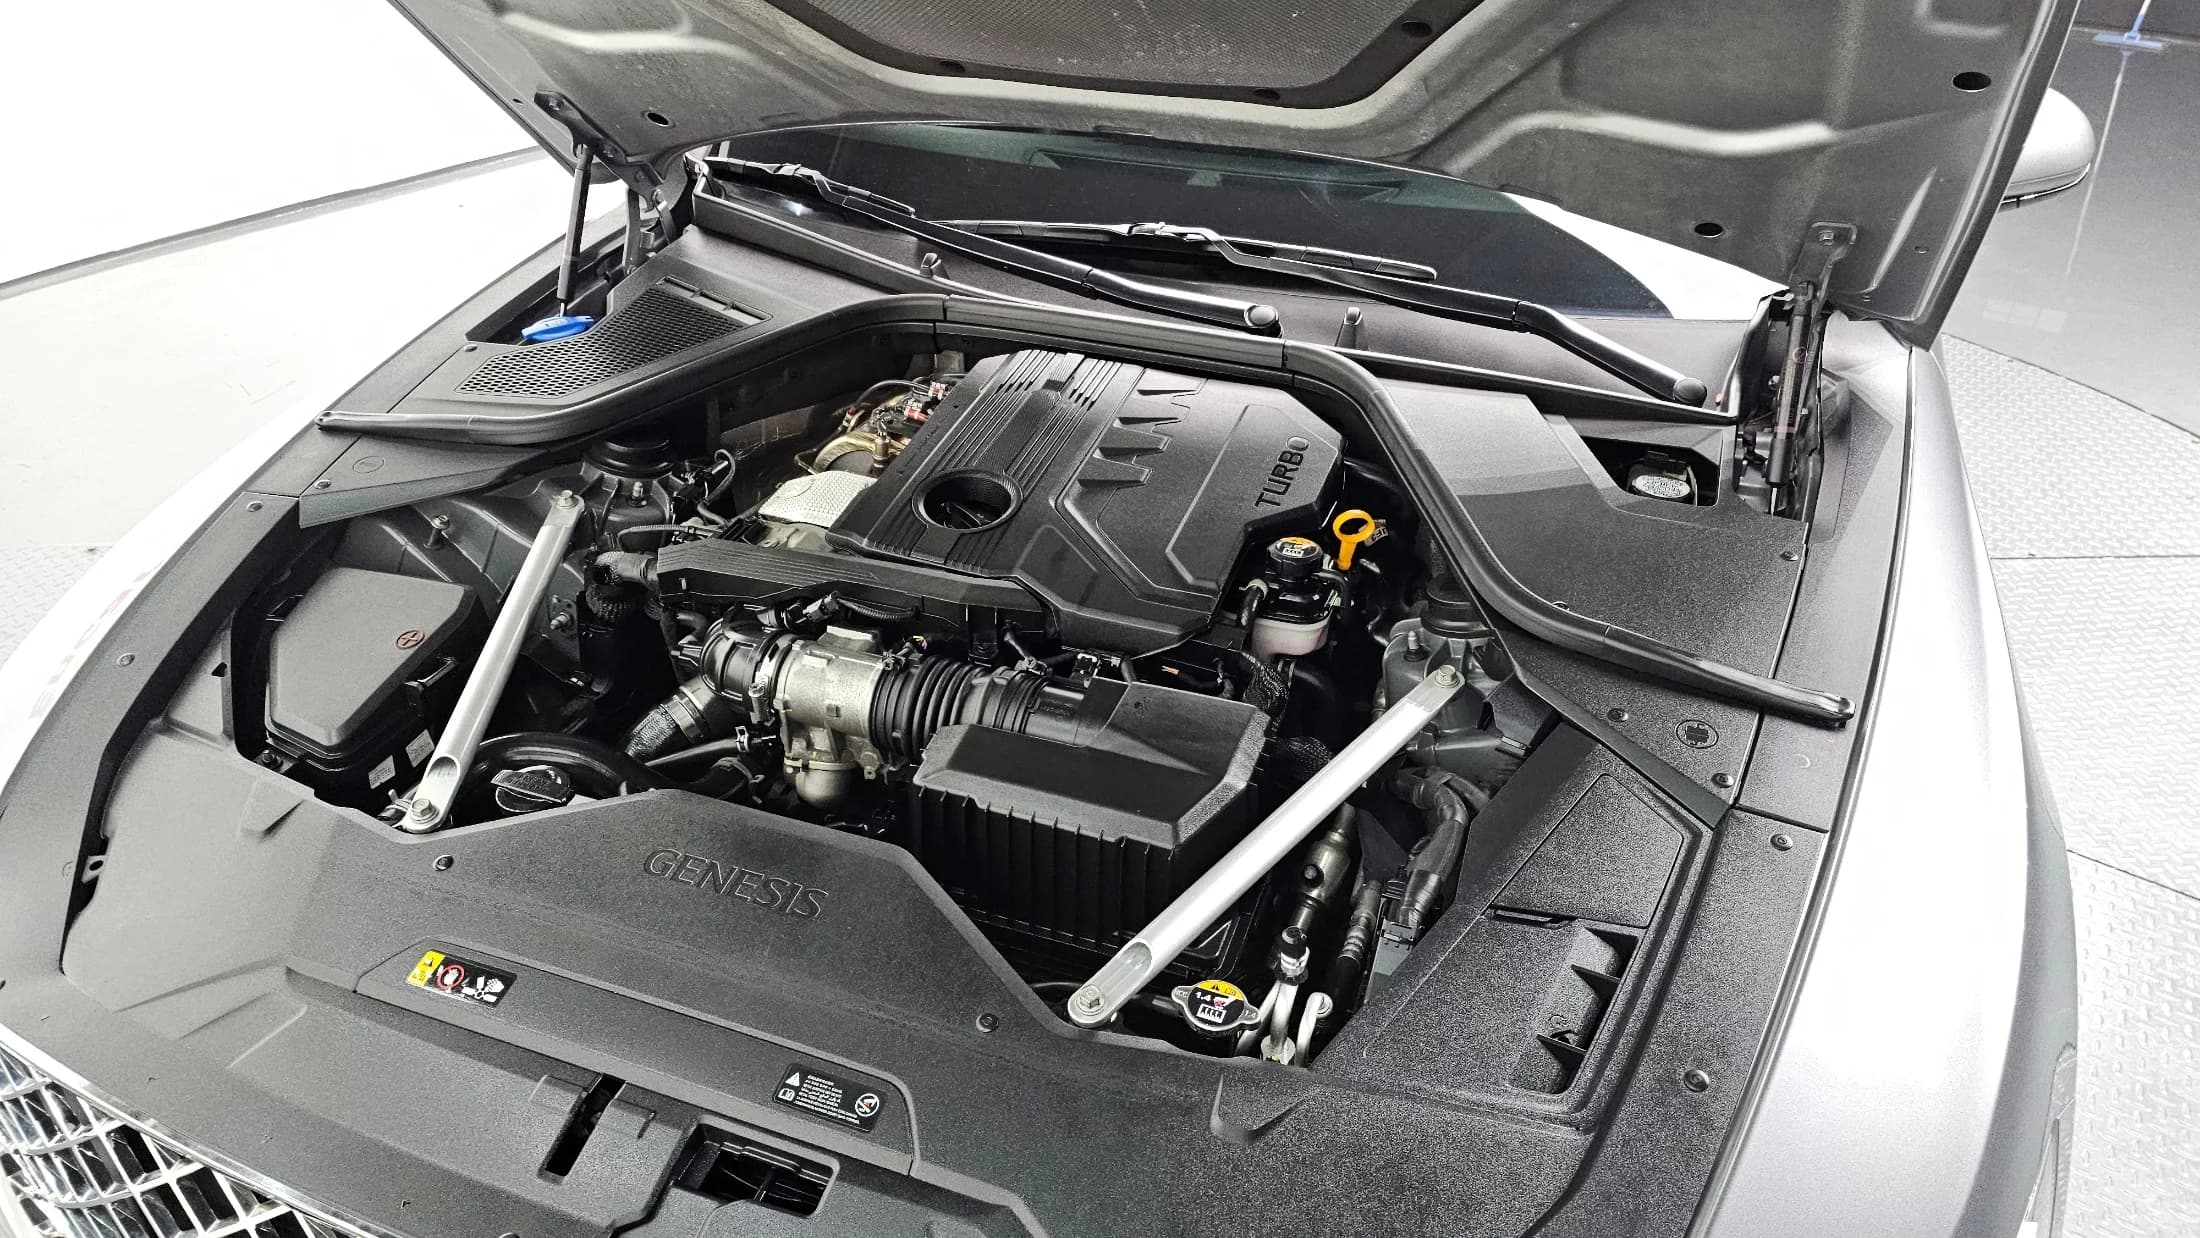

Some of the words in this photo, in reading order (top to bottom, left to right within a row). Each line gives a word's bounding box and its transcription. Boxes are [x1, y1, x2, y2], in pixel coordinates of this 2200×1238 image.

[1254, 436, 1310, 507] TURBO
[644, 849, 829, 917] GENESIS
[1195, 991, 1211, 1002] 1.4
